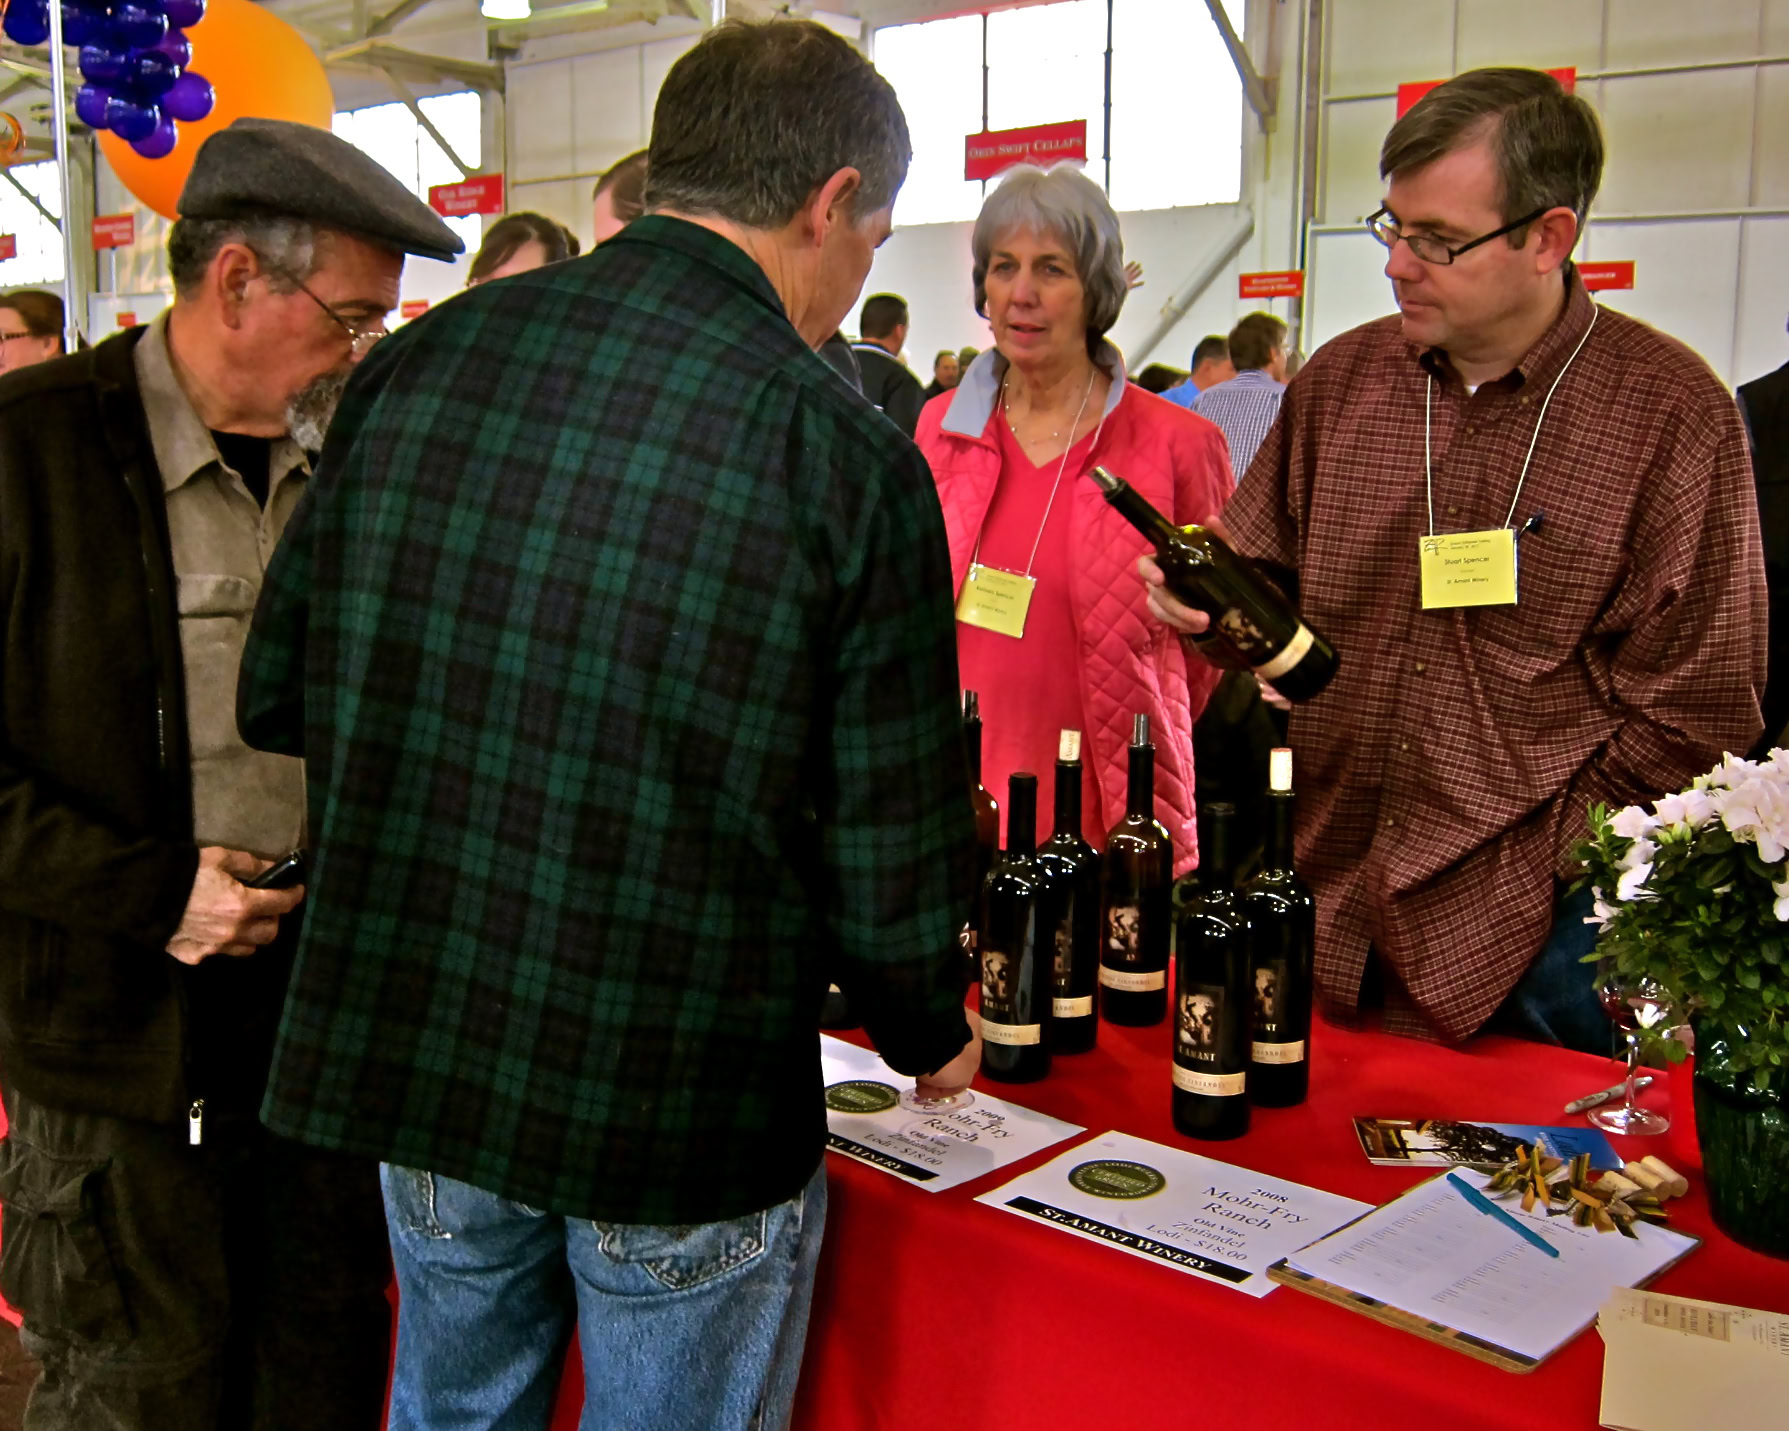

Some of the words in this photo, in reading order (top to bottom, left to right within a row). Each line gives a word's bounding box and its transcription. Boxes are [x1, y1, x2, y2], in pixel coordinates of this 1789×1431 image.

[999, 142, 1031, 154] SWIFT
[1034, 137, 1083, 151] CELLARS
[1463, 556, 1490, 565] Spencer
[948, 1113, 1014, 1139] ohr-Fry
[975, 1109, 1006, 1121] 2009
[923, 1118, 979, 1143] Ranch
[848, 1145, 906, 1170] WINERY
[1201, 1186, 1309, 1224] Mohr-Fry
[1250, 1188, 1290, 1204] 2008
[1193, 1218, 1216, 1229] Old
[1219, 1225, 1246, 1238] Vine
[1201, 1202, 1272, 1230] Ranch
[1146, 1224, 1184, 1240] Lodi
[1193, 1240, 1248, 1261] $18.00
[1172, 1221, 1246, 1249] Zinfandel
[1136, 1239, 1213, 1269] WINERY
